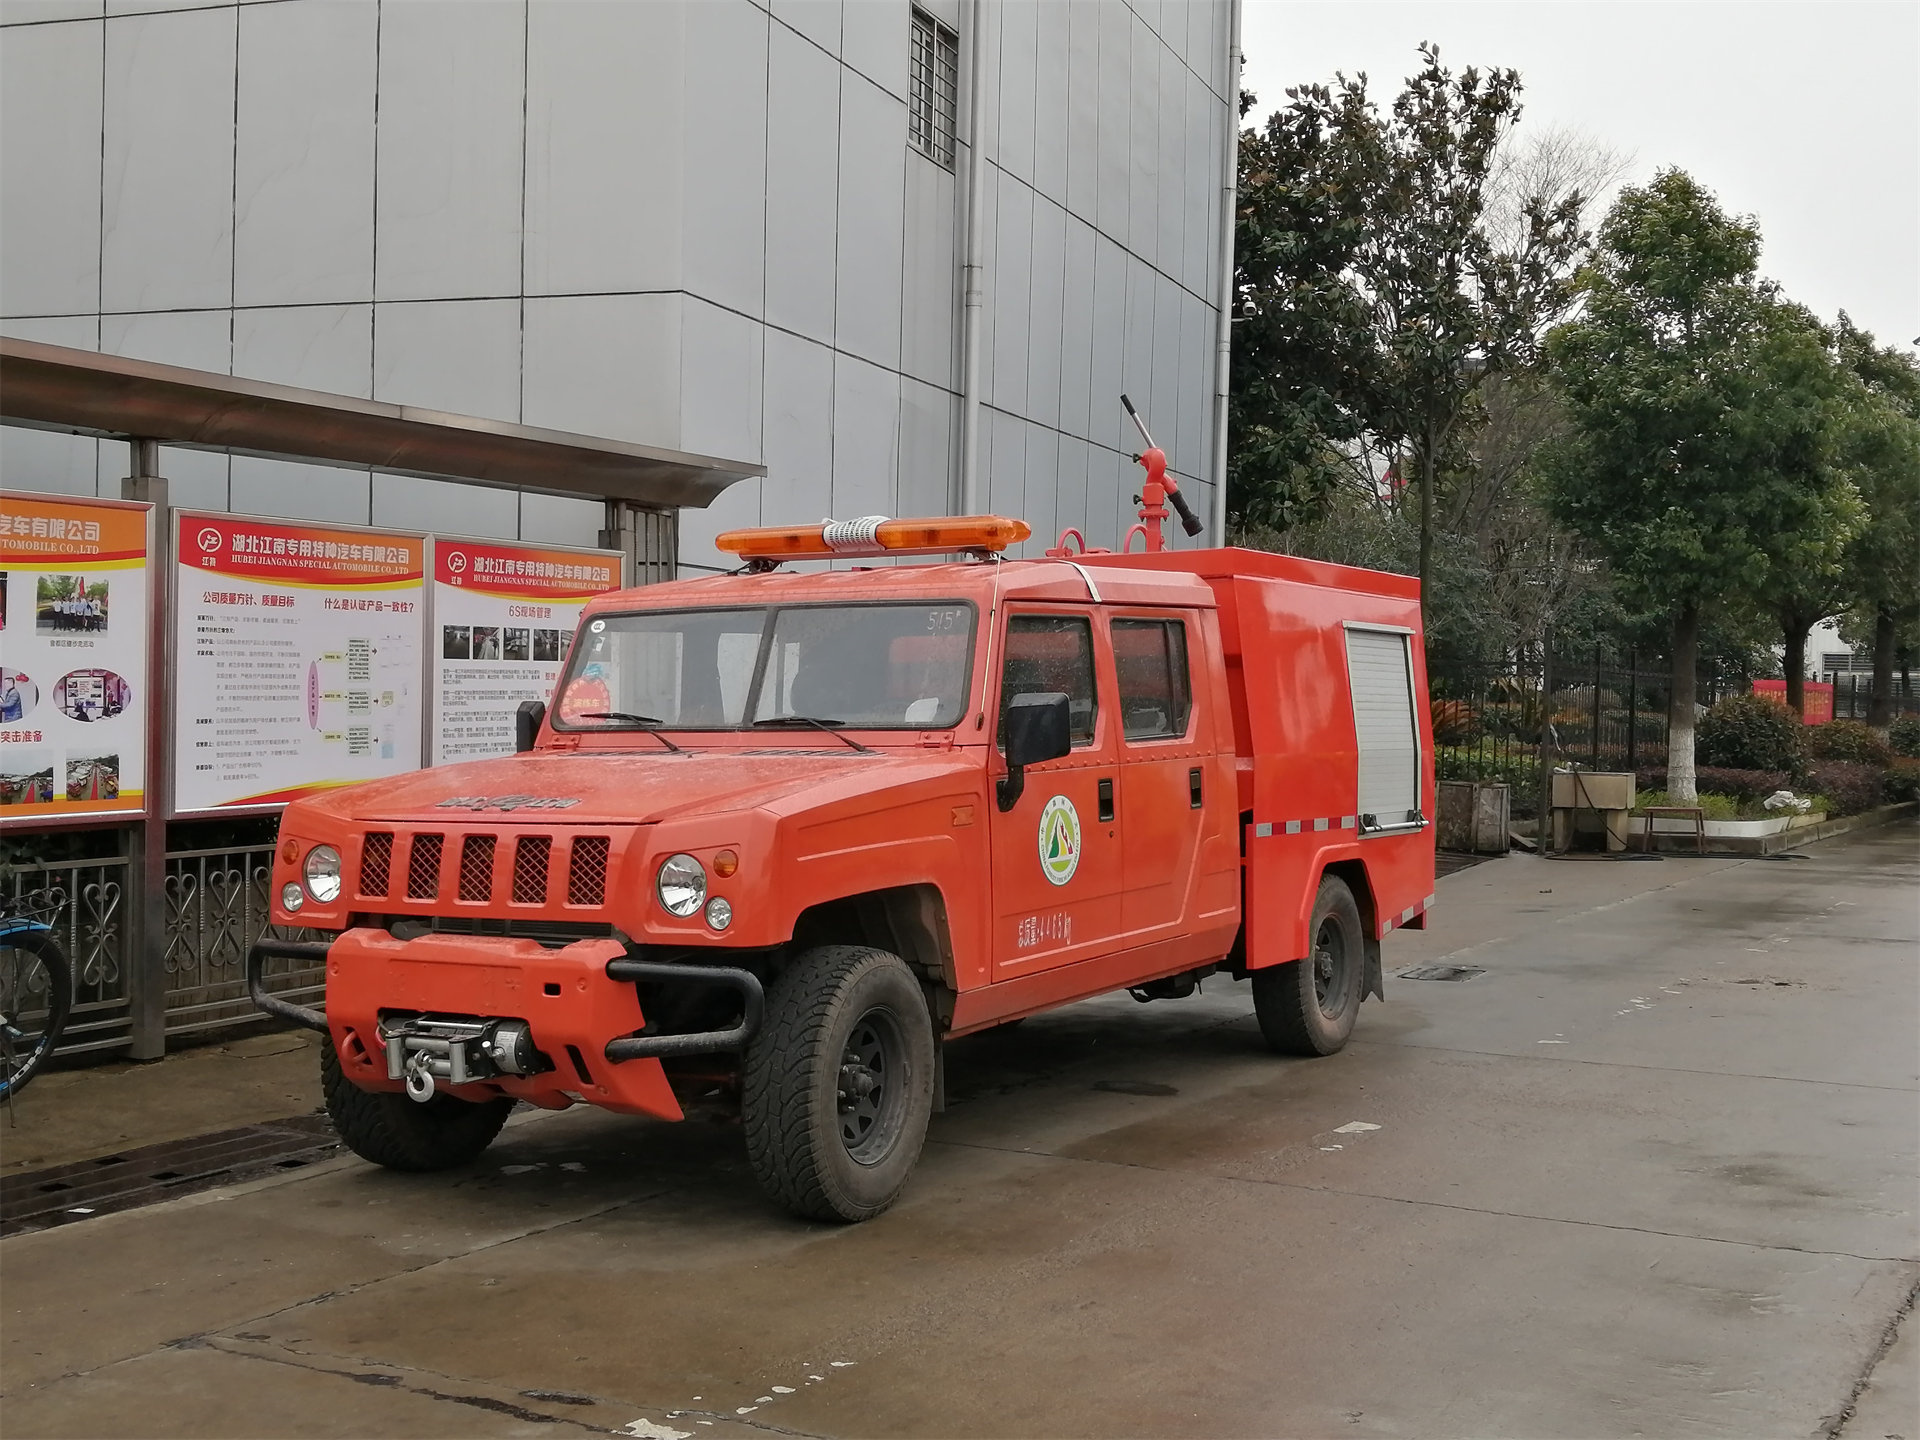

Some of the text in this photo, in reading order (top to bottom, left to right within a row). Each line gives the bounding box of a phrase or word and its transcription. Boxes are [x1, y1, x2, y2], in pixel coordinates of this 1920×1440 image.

[0, 538, 56, 552] TOMOBILE
[232, 533, 409, 564] 湖北江南专用特种汽车有限公司
[231, 555, 257, 564] HUBEI
[257, 556, 299, 567] JIANGNAN
[300, 559, 331, 569] SPECIAL
[331, 561, 380, 573] AUTOMOBILE
[473, 556, 610, 582] 湖北江南专用特种汽车有限公司
[473, 574, 493, 583] HUBEI
[493, 576, 525, 585] JIANGNAN
[525, 578, 549, 587] SPECIAL
[550, 580, 587, 590] AUTOMOBILE
[202, 591, 295, 608] 公司质量方针、质量目标
[508, 605, 552, 619] 6S现场管理
[1, 730, 43, 743] 突击准备
